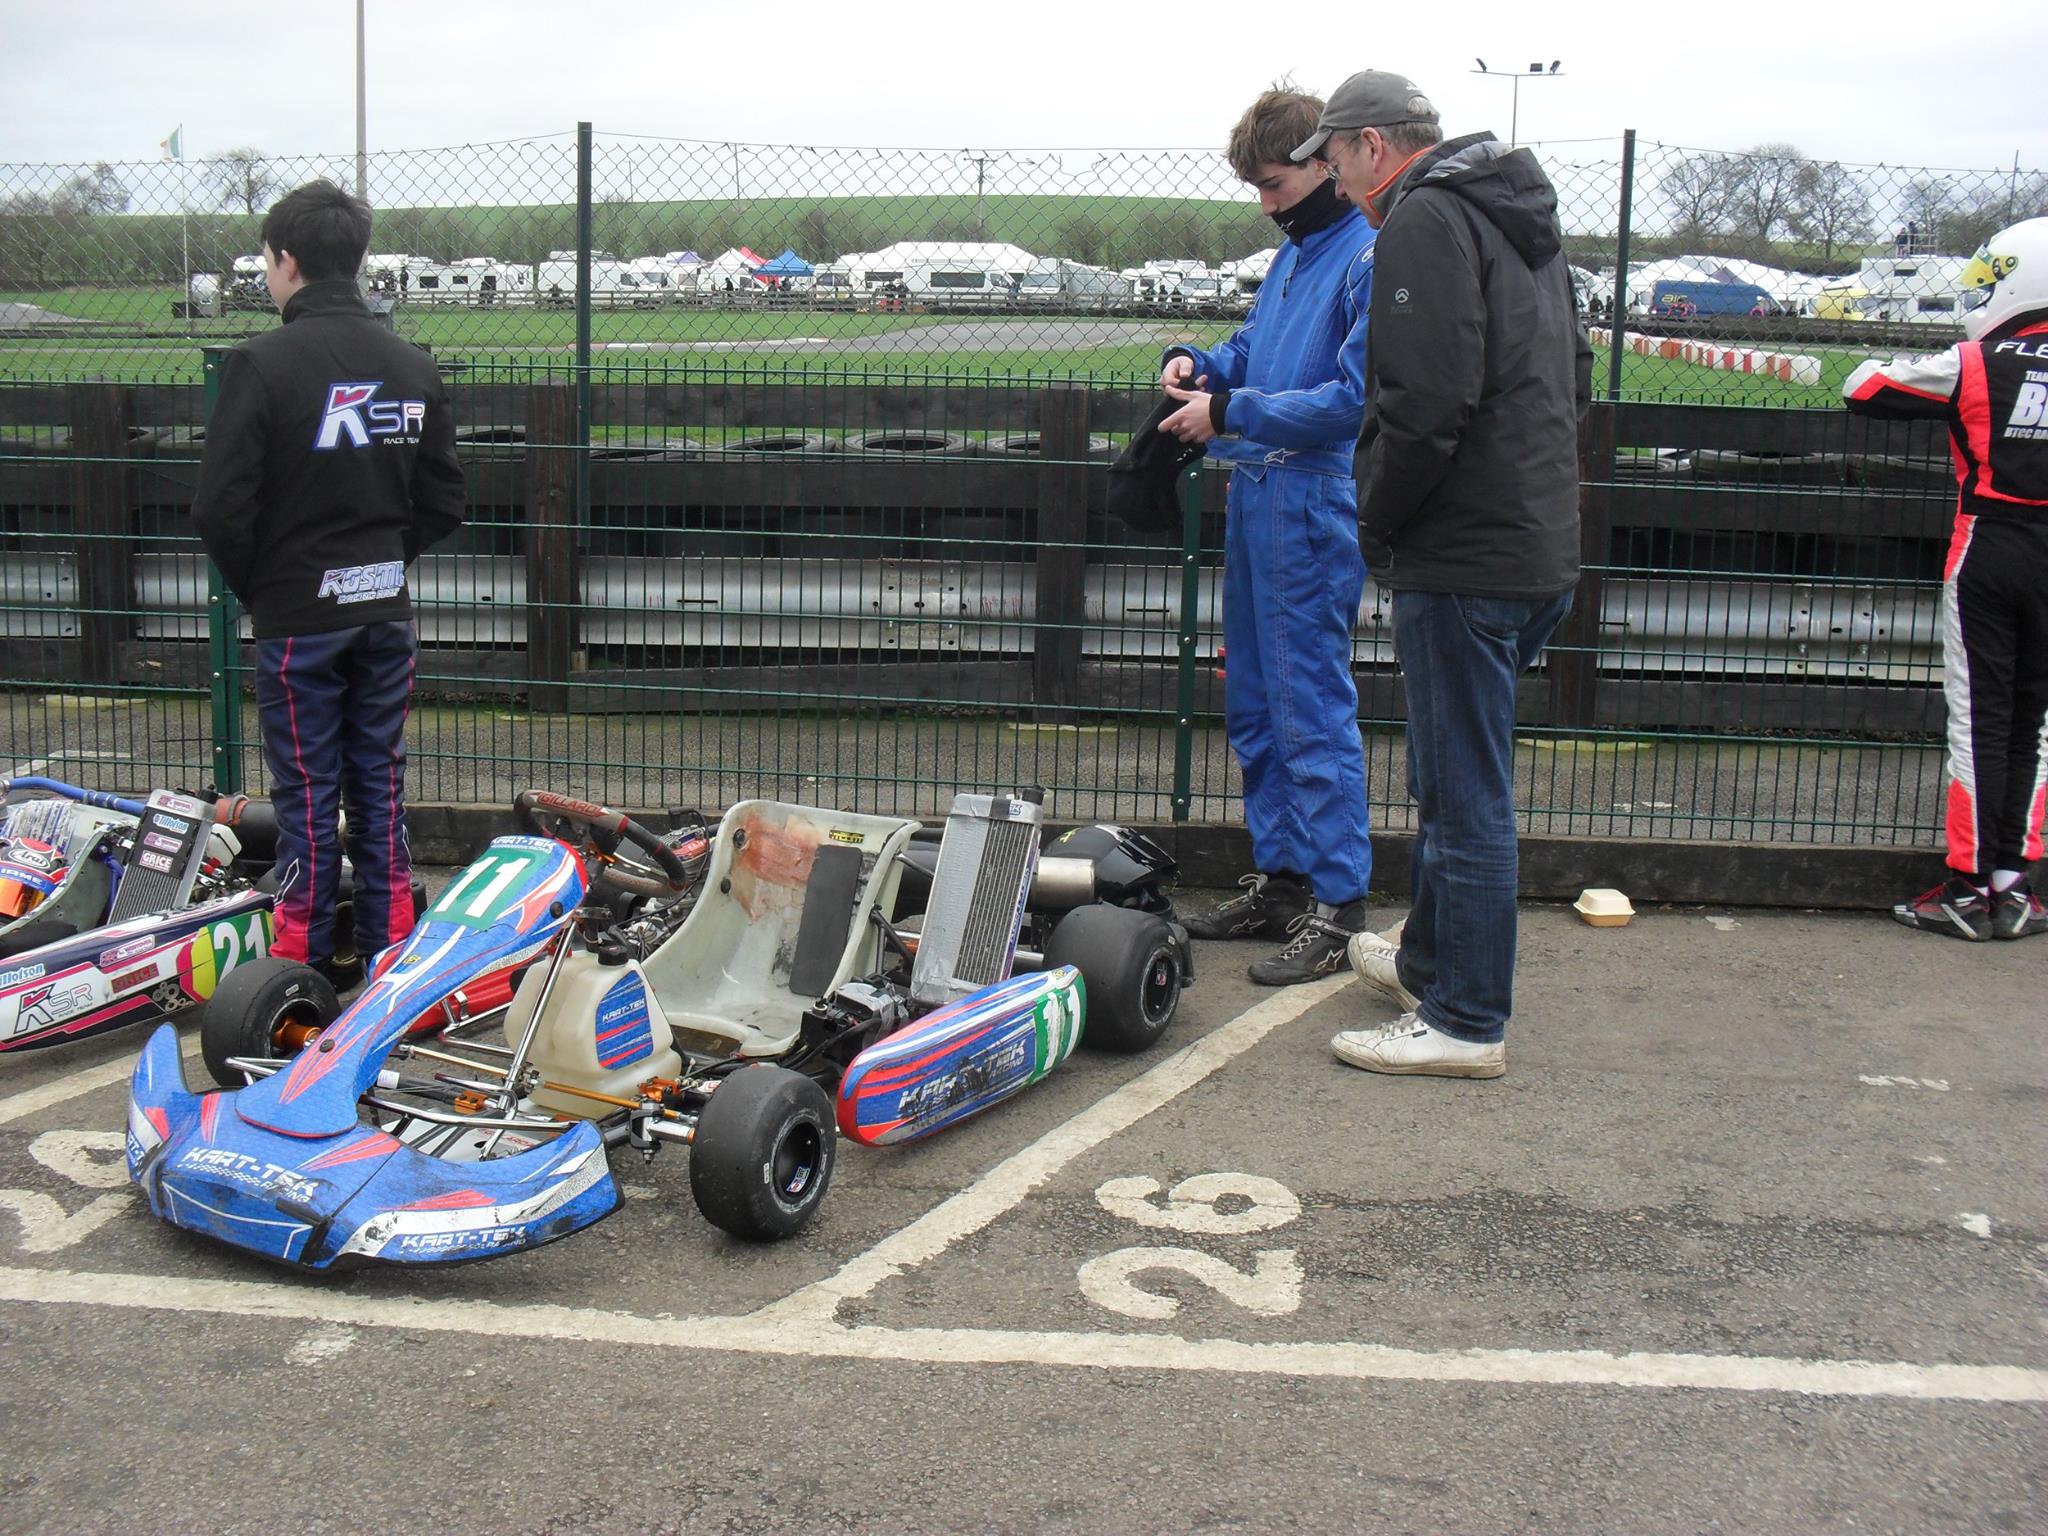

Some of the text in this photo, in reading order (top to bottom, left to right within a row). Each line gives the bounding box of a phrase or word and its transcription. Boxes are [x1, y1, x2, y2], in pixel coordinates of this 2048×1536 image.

[313, 381, 426, 450] KSR
[2008, 382, 2048, 427] B
[383, 436, 405, 445] RACE
[2003, 427, 2034, 439] BTCC
[540, 791, 600, 815] GILLARD
[12, 850, 47, 866] Arai
[143, 852, 173, 867] GRICE
[434, 856, 531, 918] 11
[213, 913, 267, 983] 21
[14, 983, 93, 1035] KSR
[602, 998, 645, 1023] KART-TEK
[182, 1147, 320, 1198] KART-TEK
[400, 1226, 526, 1249] KART-TEK
